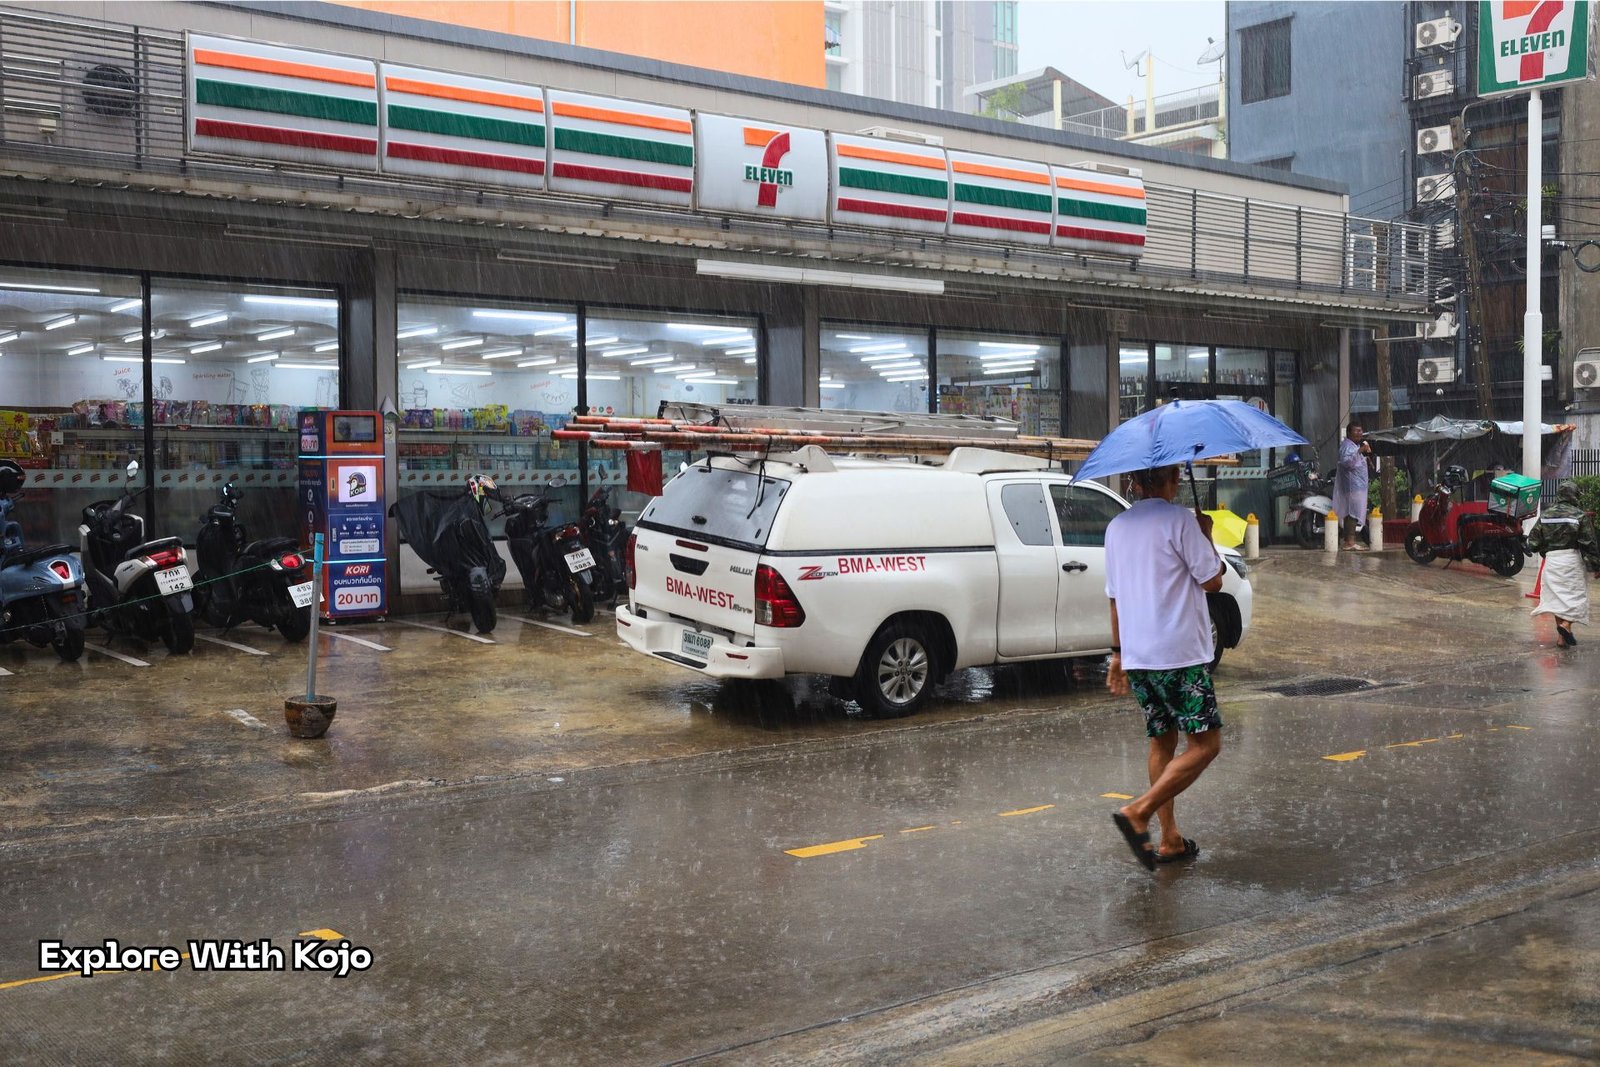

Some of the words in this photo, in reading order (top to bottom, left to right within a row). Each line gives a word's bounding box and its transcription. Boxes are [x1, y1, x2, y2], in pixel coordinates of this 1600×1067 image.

[1502, 0, 1564, 82] 7
[742, 127, 791, 208] 7
[345, 565, 370, 575] KORI
[730, 565, 753, 576] HILUX
[837, 556, 926, 574] BMA-WEST
[169, 582, 185, 592] 142
[666, 576, 735, 610] BMA-WEST
[338, 594, 353, 605] 20
[355, 593, 378, 603] บาท
